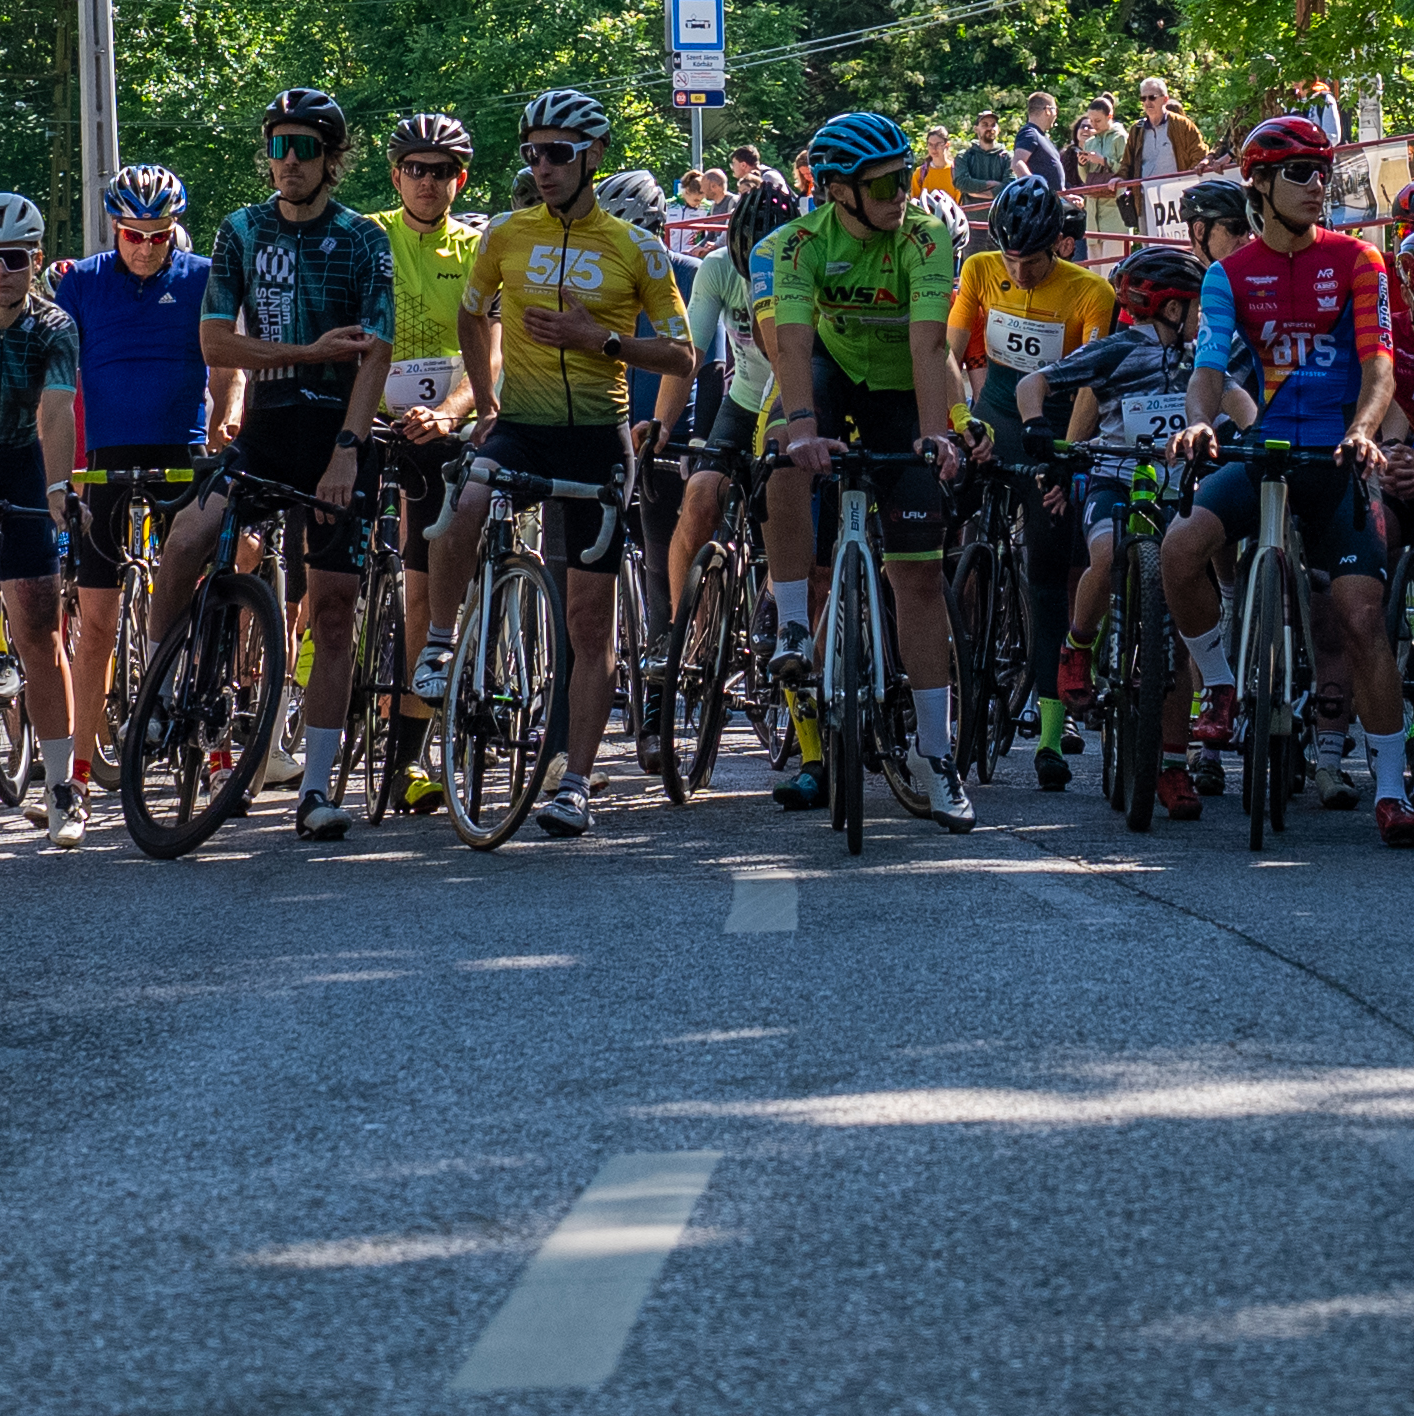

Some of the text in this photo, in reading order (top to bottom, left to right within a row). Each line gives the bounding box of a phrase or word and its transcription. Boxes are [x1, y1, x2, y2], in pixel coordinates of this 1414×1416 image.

[524, 244, 604, 291] 575
[281, 289, 294, 325] Team
[822, 286, 901, 305] WSA
[267, 287, 283, 344] UNITED
[1006, 332, 1041, 357] 56
[1272, 332, 1337, 367] BTS
[418, 377, 437, 401] 3
[1149, 414, 1187, 440] 29
[850, 500, 859, 532] BMC
